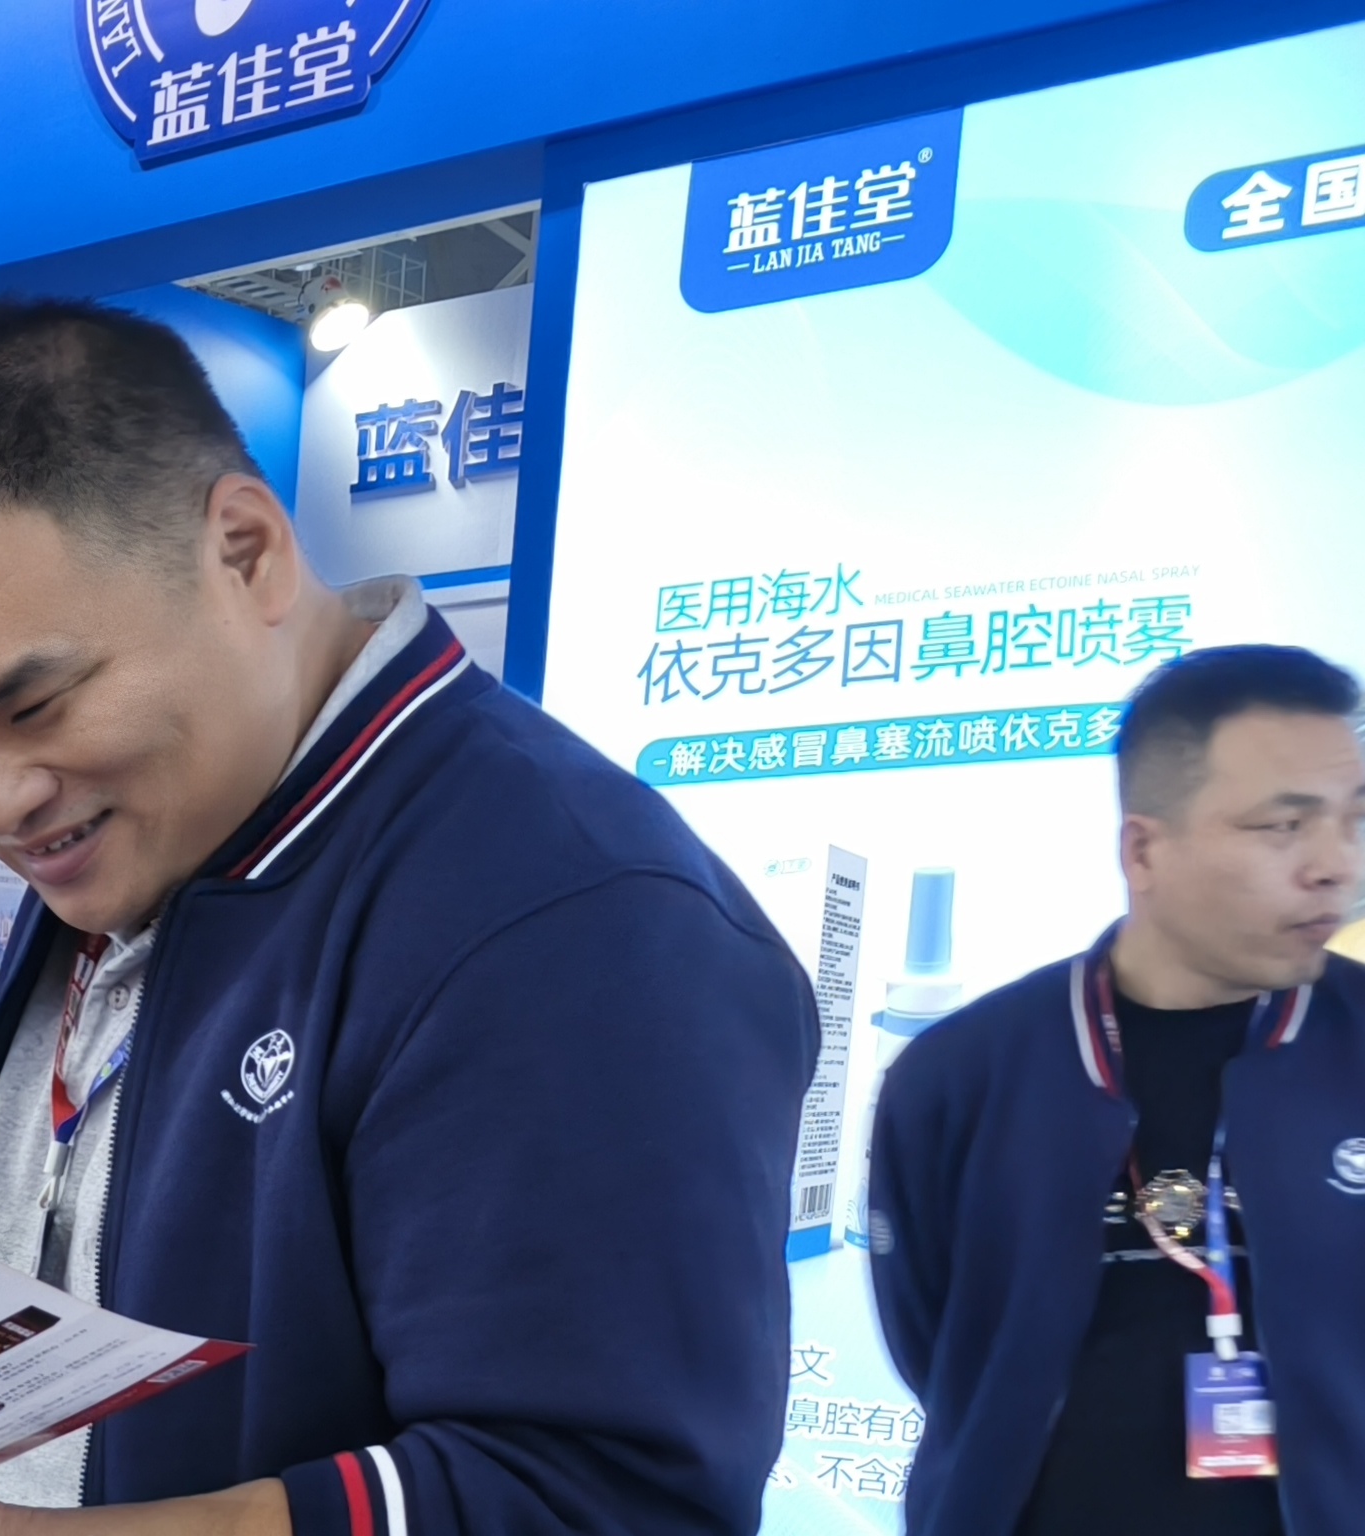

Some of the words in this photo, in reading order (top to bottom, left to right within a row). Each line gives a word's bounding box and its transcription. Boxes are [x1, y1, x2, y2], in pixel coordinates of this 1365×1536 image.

[146, 20, 357, 147] 蓝佳堂
[723, 161, 916, 254] 蓝佳堂
[753, 248, 792, 274] LAN
[796, 243, 825, 268] JIA
[831, 231, 881, 261] TANG
[350, 381, 525, 499] 蓝佳
[656, 562, 865, 633] 医用海水
[944, 581, 1026, 600] SEAWATER
